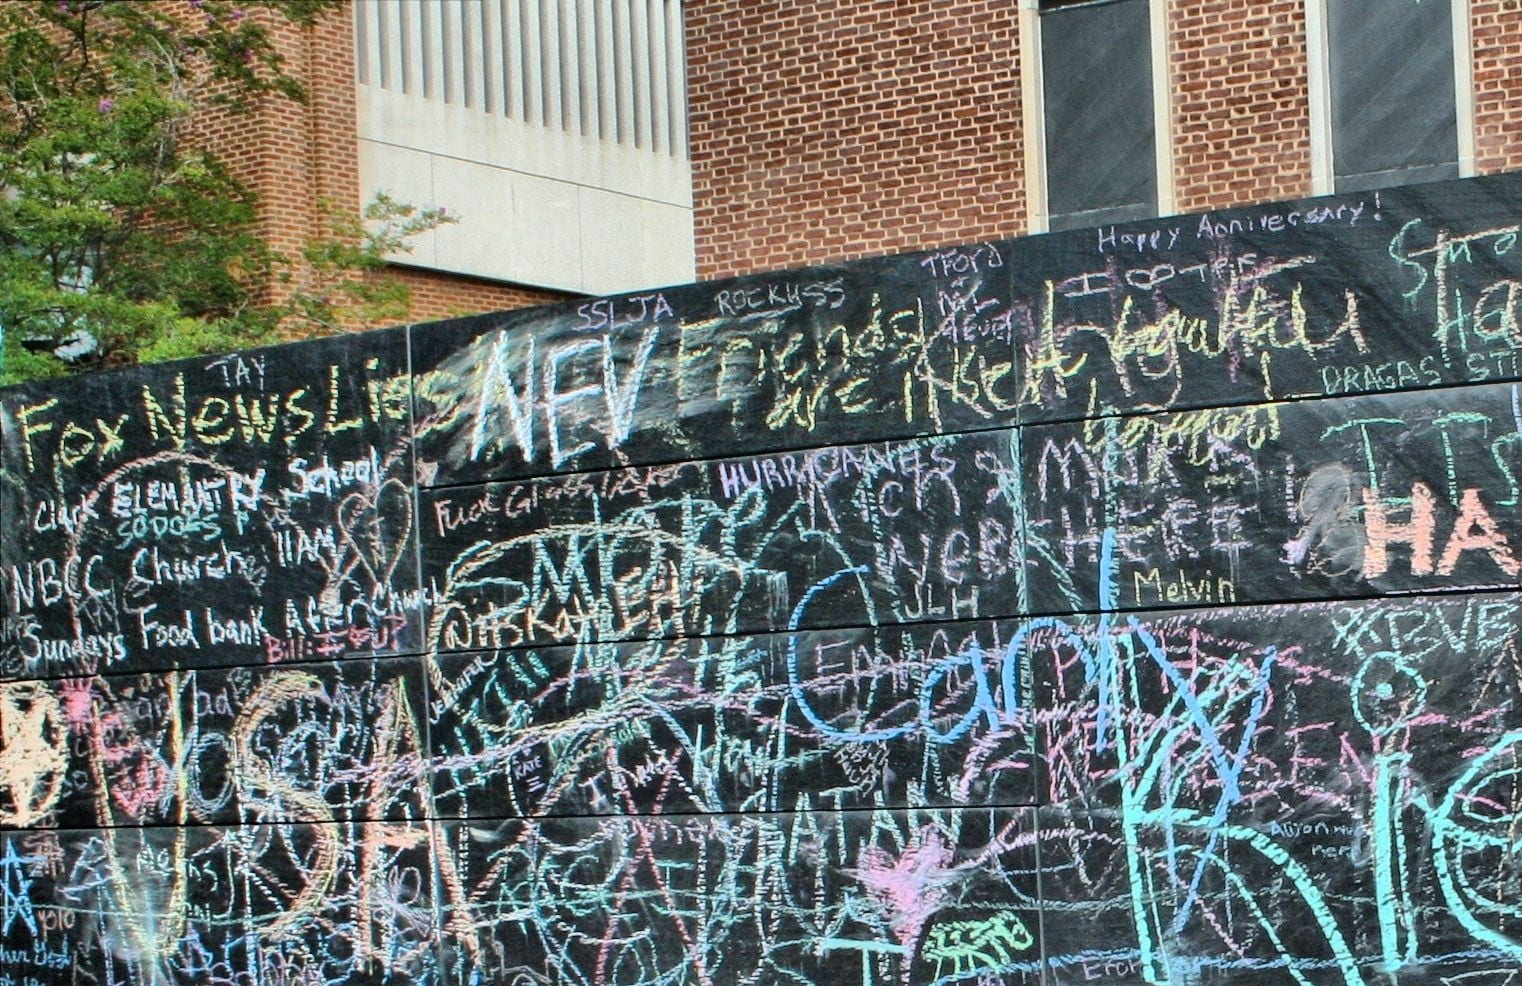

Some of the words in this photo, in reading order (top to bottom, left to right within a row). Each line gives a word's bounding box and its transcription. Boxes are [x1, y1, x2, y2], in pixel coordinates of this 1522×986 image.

[1097, 225, 1182, 253] Happy
[1196, 191, 1384, 240] Anniversary!
[1319, 354, 1442, 395] DRAGAS
[15, 397, 128, 474] Fox
[143, 372, 315, 449] News
[287, 446, 381, 500] School
[434, 485, 500, 538] Fuck
[130, 539, 247, 586] Church
[1133, 569, 1238, 608] Melvin
